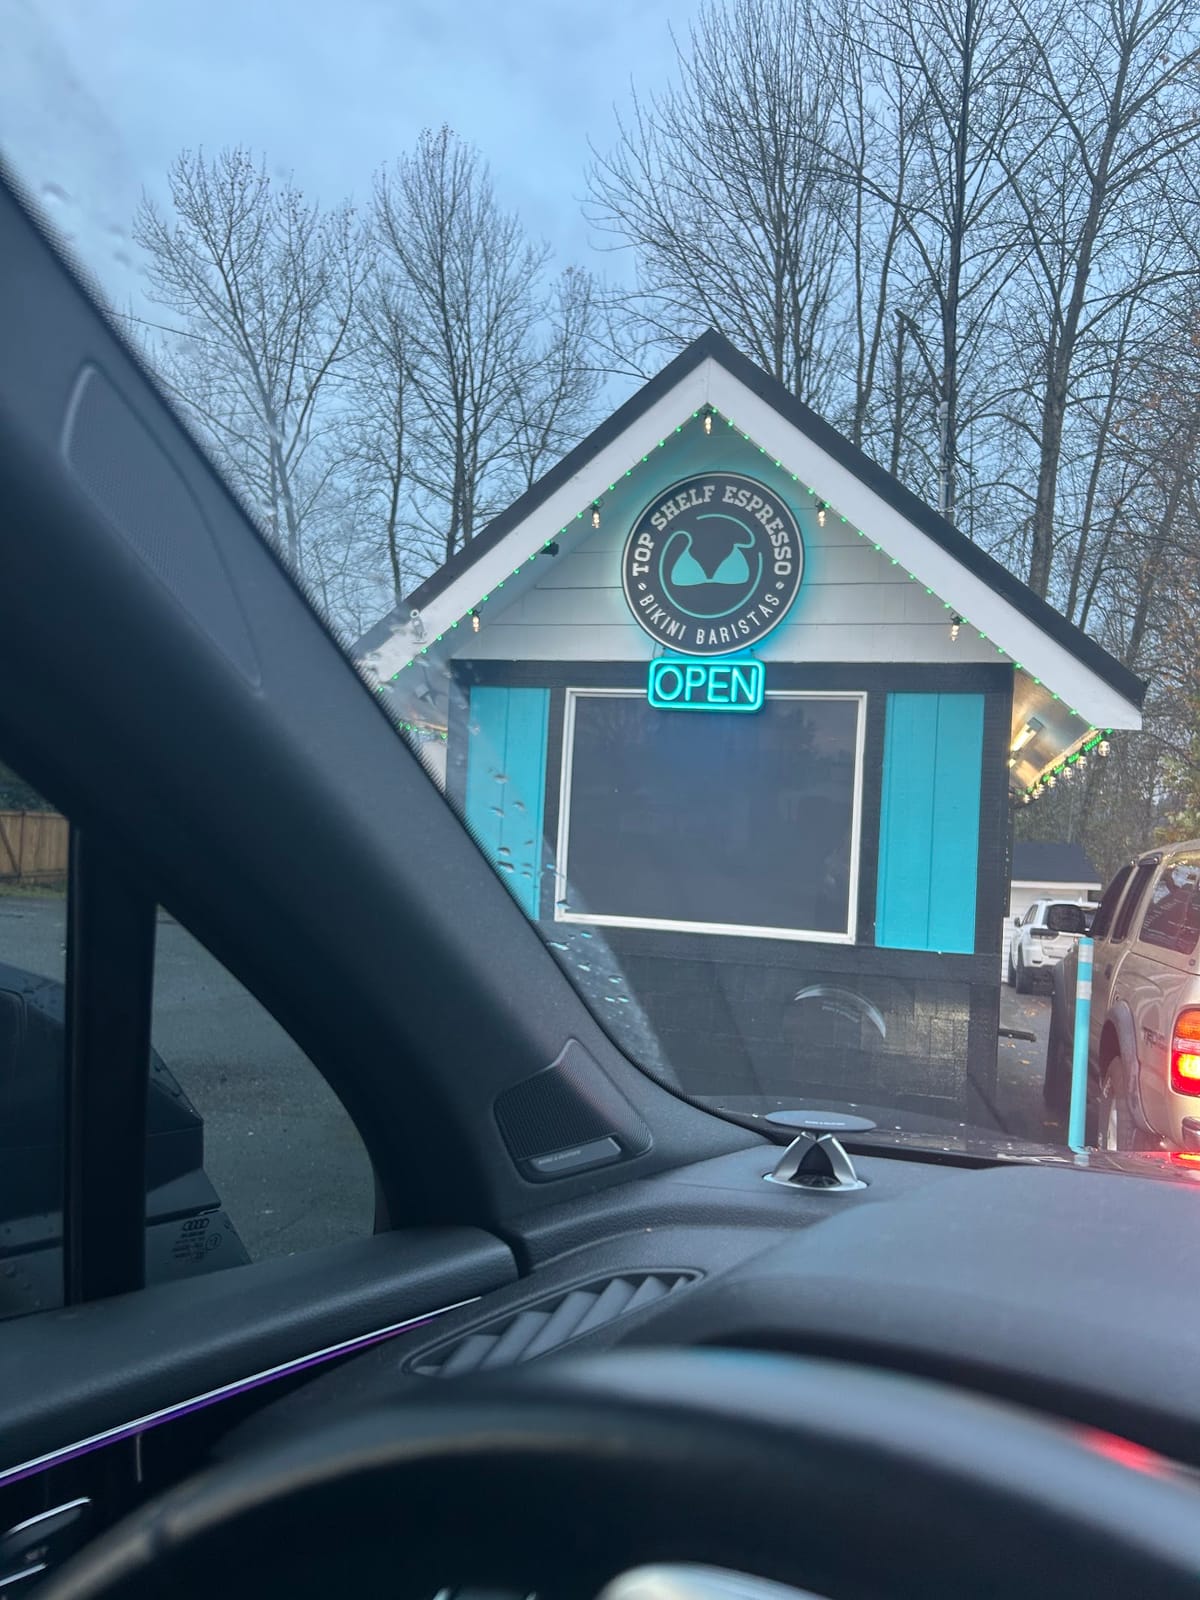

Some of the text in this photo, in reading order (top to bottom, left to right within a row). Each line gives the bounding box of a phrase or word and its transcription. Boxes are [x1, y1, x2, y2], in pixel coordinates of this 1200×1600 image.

[632, 485, 792, 577] TOP SHELF ESPRESSO
[639, 593, 780, 645] BIKINI BARISTAS
[655, 666, 757, 702] OPEN
